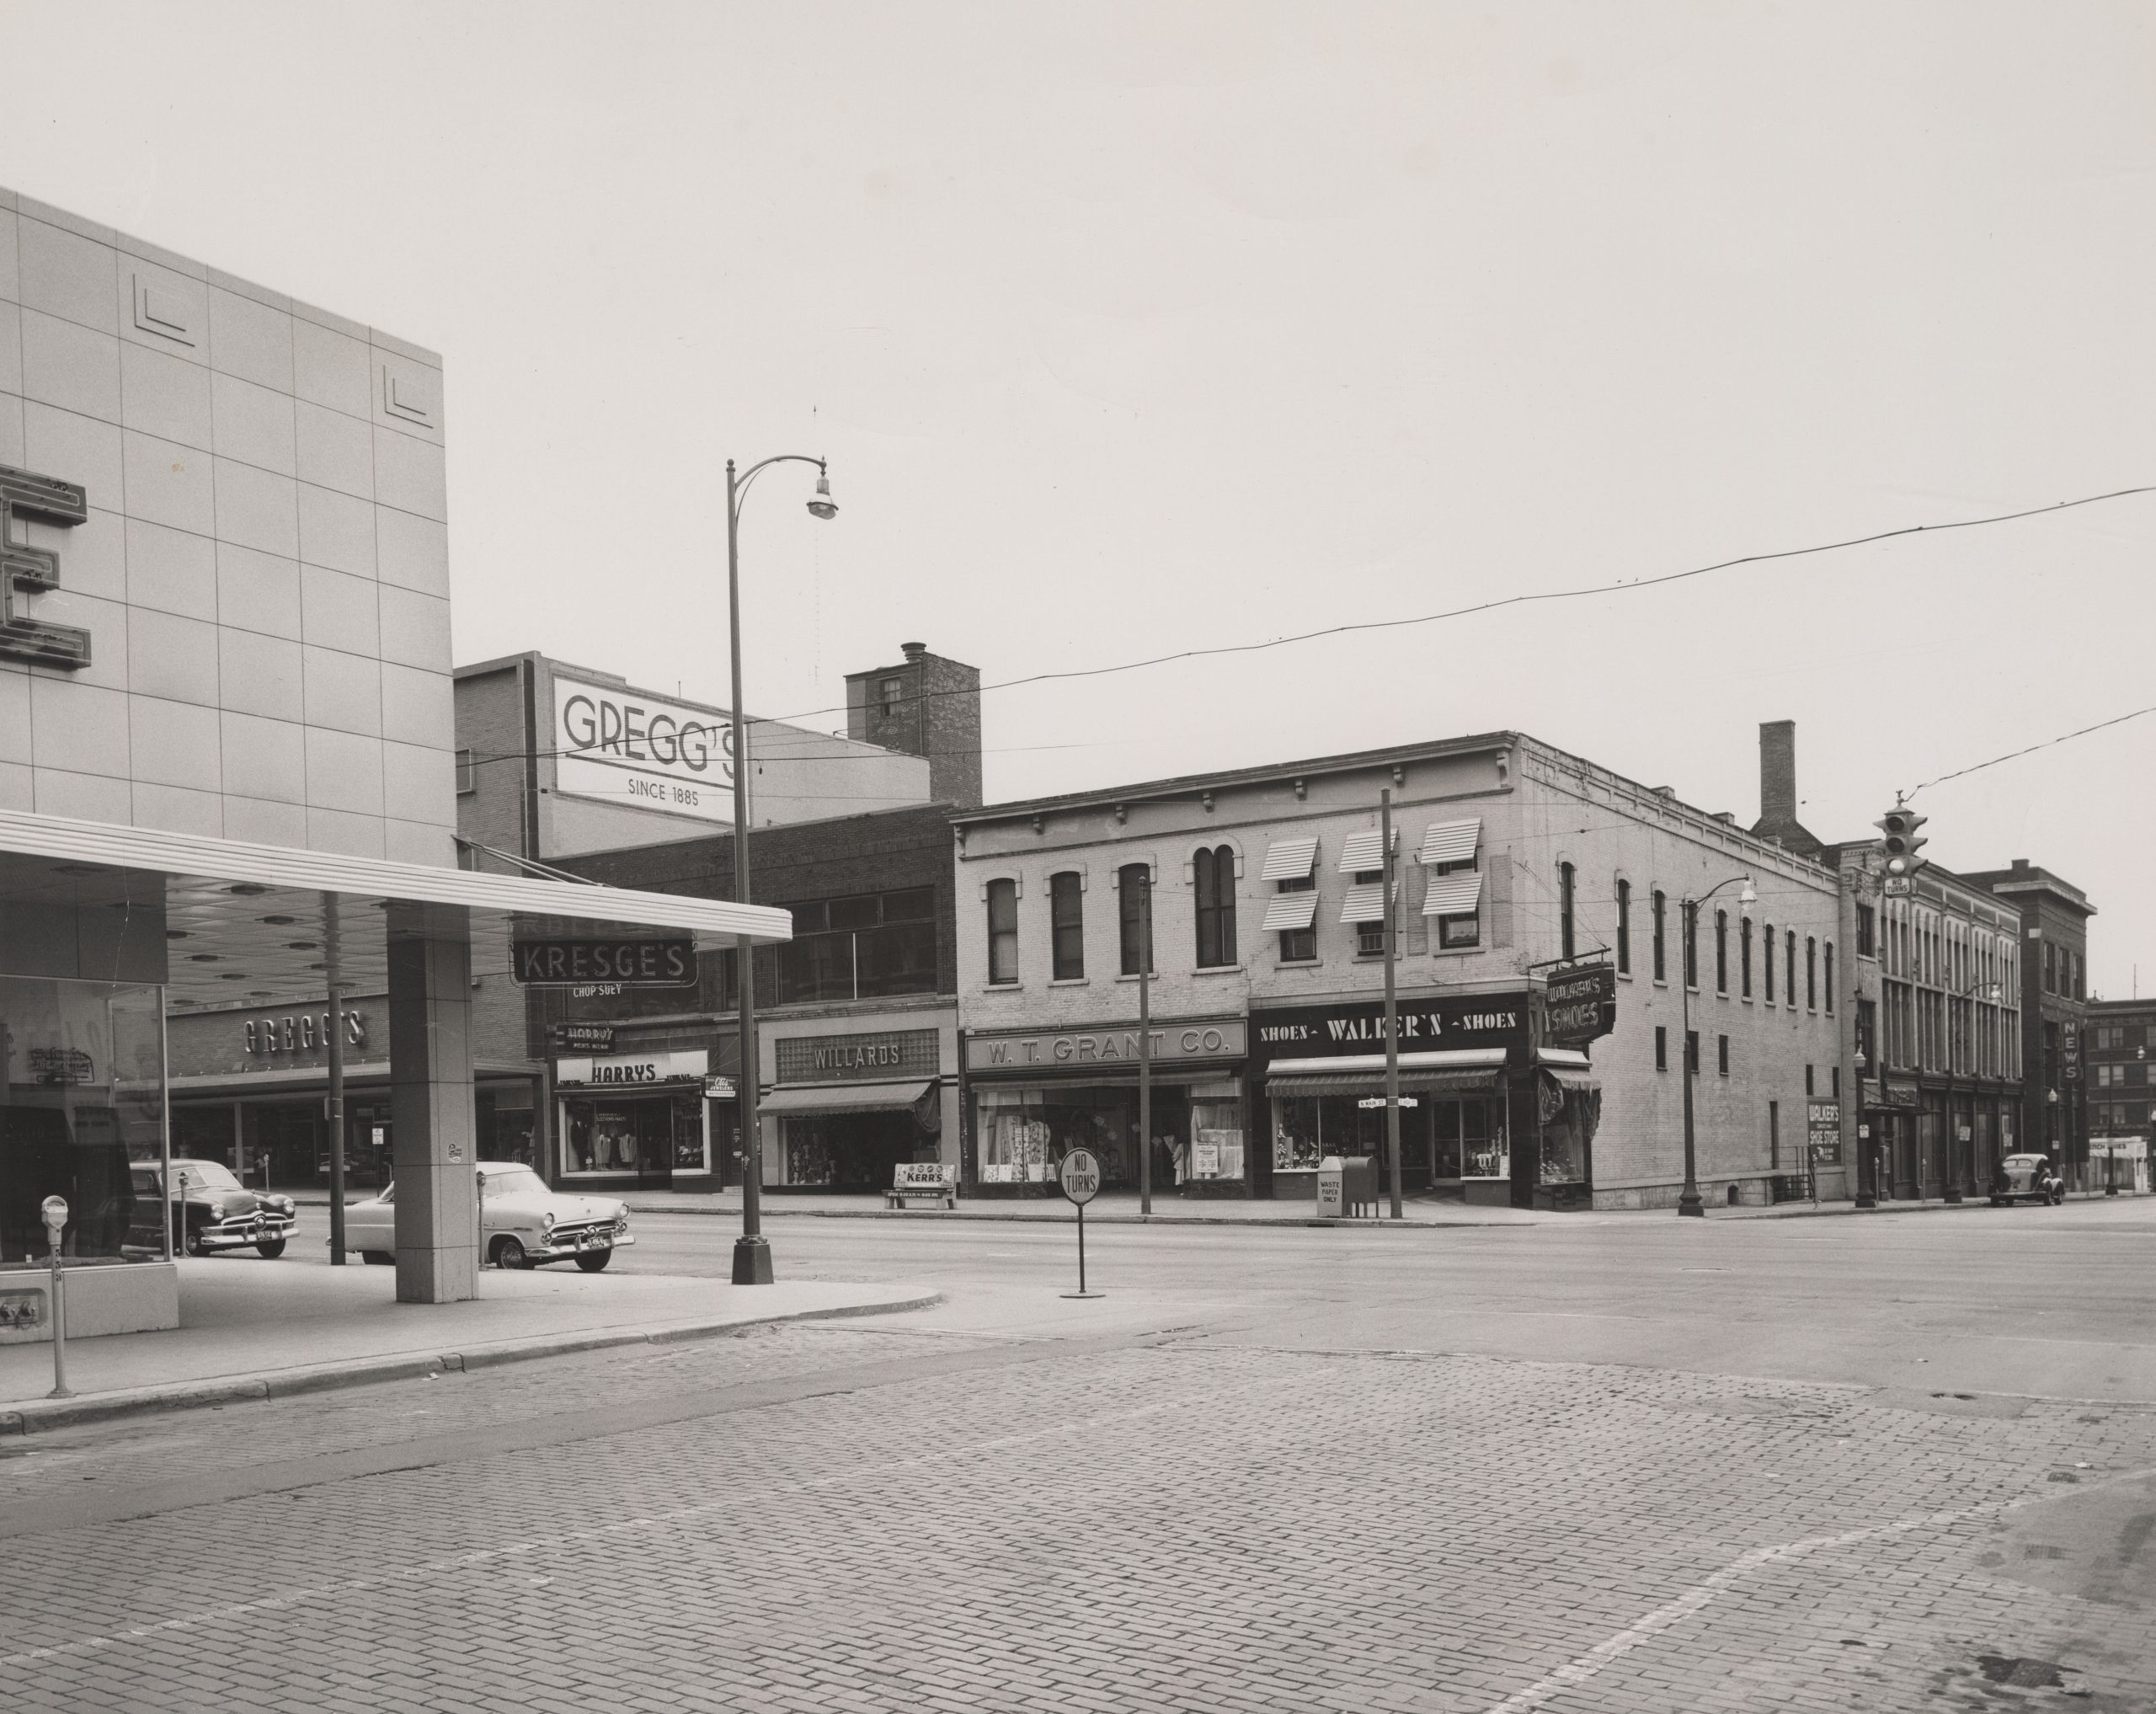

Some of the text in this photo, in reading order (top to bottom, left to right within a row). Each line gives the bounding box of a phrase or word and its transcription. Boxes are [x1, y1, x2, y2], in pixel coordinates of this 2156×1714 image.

[563, 695, 734, 780] GREGG'S
[628, 778, 699, 806] SINCE 1885
[1887, 884, 1908, 893] TURNS
[524, 945, 685, 978] KRESGE'S
[573, 984, 622, 998] CHOP SUEY
[1547, 977, 1600, 1002] WALKER'S
[1260, 1012, 1517, 1042] SHOES WALKER'S SHOES
[1551, 1001, 1598, 1031] SHOES
[567, 1028, 613, 1041] HARRY'S
[814, 1045, 899, 1070] WILLARDS
[986, 1028, 1230, 1065] W. T. GRANT CO.
[2064, 1023, 2078, 1078] NEWS
[591, 1063, 656, 1083] HARRYS
[1808, 1104, 1839, 1122] WALKER'S
[1810, 1130, 1839, 1145] SHOE STORE
[1075, 1154, 1086, 1172] NO
[906, 1172, 943, 1183] KERR'S
[1065, 1174, 1096, 1193] TURNS
